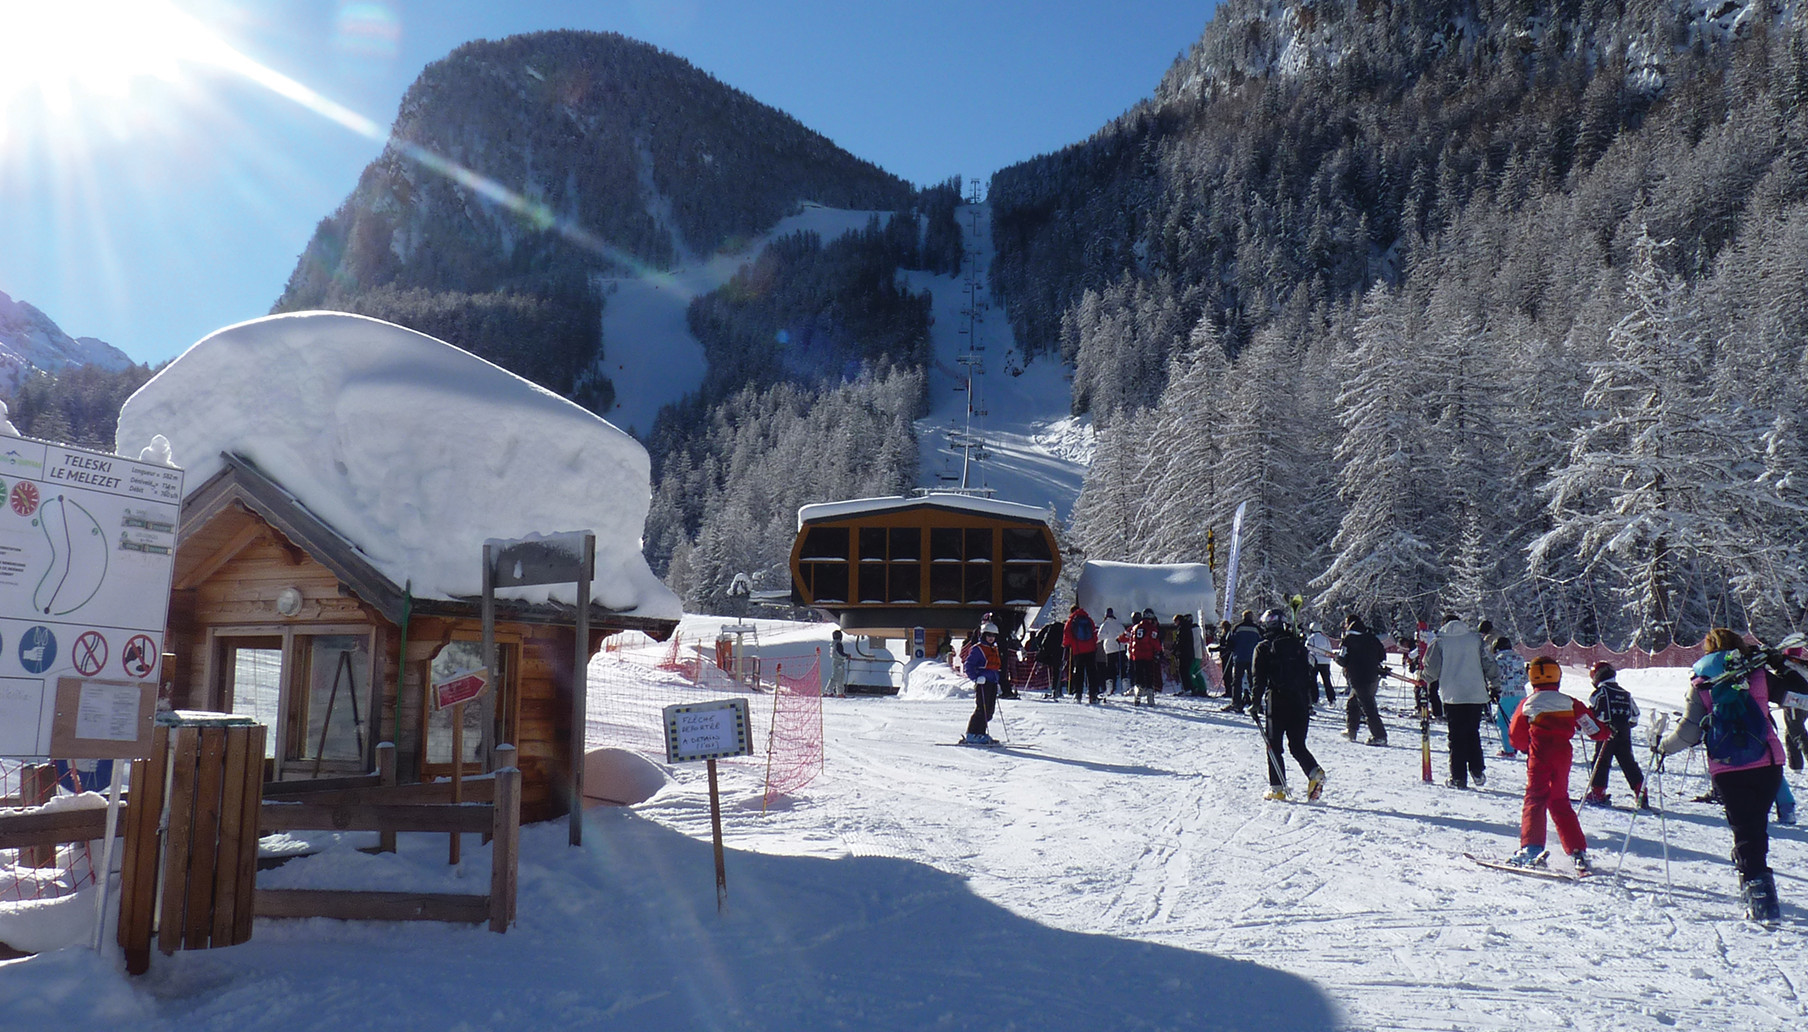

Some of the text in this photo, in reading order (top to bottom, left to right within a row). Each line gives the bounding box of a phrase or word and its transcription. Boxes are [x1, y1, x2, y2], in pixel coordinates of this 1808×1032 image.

[64, 454, 112, 473] TELESKI
[50, 467, 122, 489] LE MELEZET
